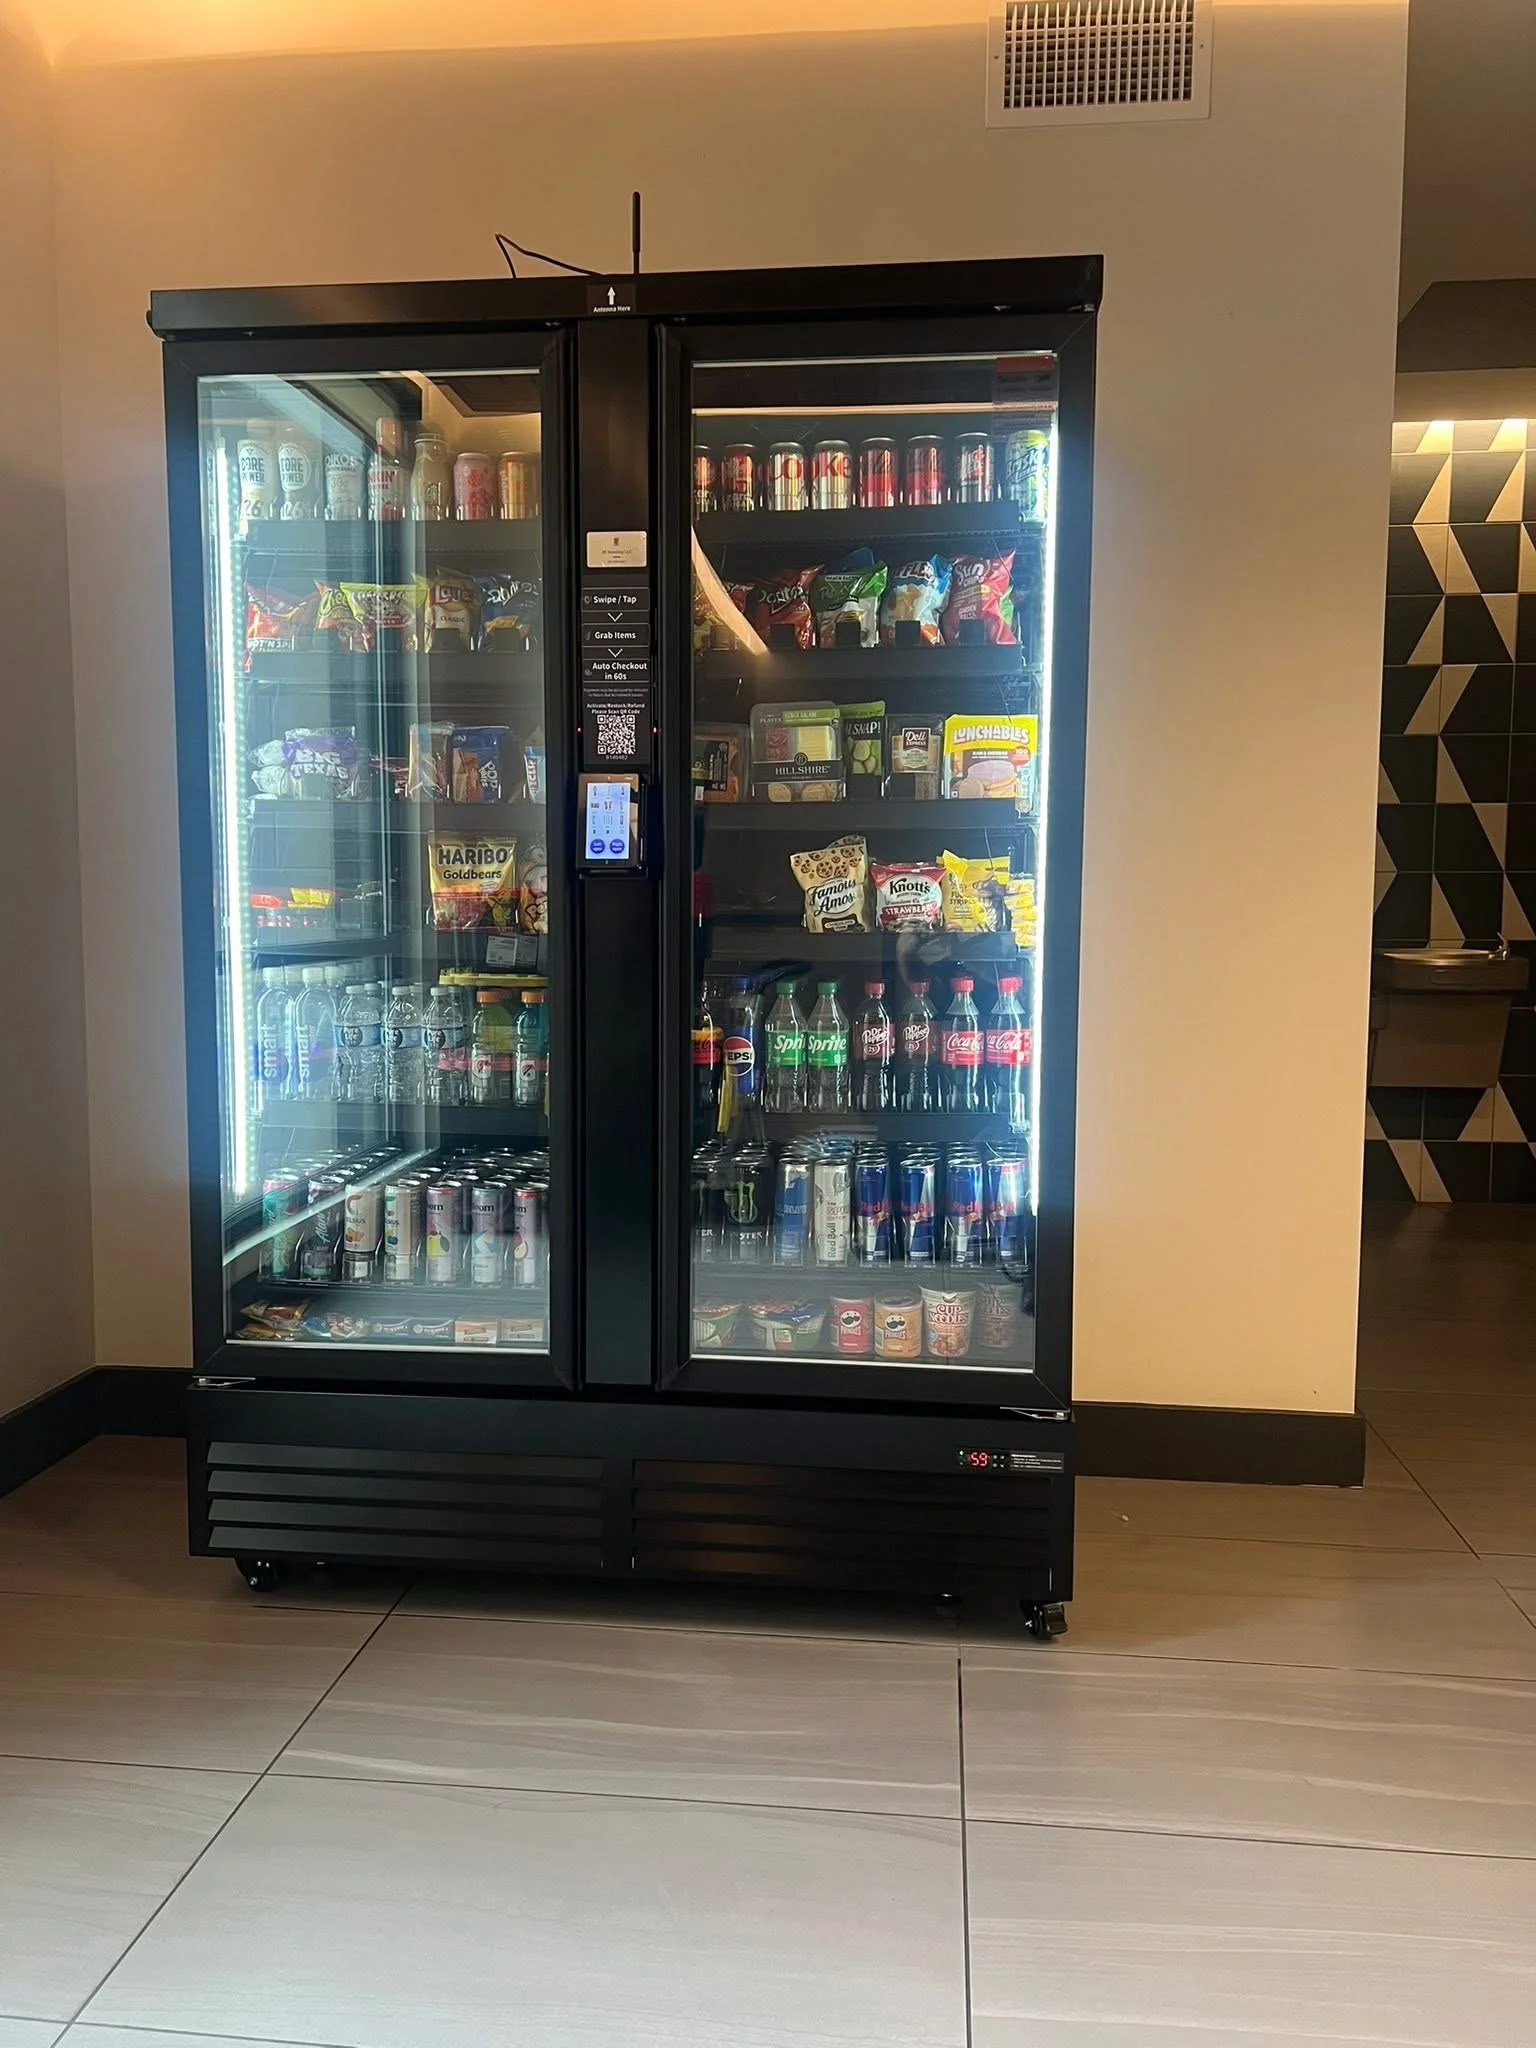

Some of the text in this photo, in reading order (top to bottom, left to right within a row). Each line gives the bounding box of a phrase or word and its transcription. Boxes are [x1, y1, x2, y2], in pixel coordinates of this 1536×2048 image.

[241, 457, 265, 471] CORE
[281, 457, 304, 472] CORE
[324, 454, 357, 467] OIKOS
[593, 595, 637, 605] Swipe / Tap
[594, 631, 636, 639] Grab Items
[592, 662, 648, 670] Auto Checkout
[604, 672, 627, 680] in 60s
[905, 730, 927, 741] Deli
[953, 724, 1030, 746] LUNCHABLES
[295, 748, 342, 765] BIG
[290, 763, 349, 780] TEXAS
[775, 765, 829, 776] HILLSHIRE
[438, 848, 508, 865] HARIBO
[443, 869, 502, 880] Goldbears
[806, 879, 857, 906] Famous
[889, 877, 931, 895] Knott's
[814, 892, 856, 917] Amos
[260, 1024, 277, 1078] smart
[807, 1034, 847, 1054] Sprite
[727, 1052, 752, 1061] EPSI
[826, 1222, 836, 1258] Red Bull
[936, 1304, 962, 1315] CUP
[928, 1312, 968, 1324] NOODLES
[970, 1451, 988, 1467] 59
